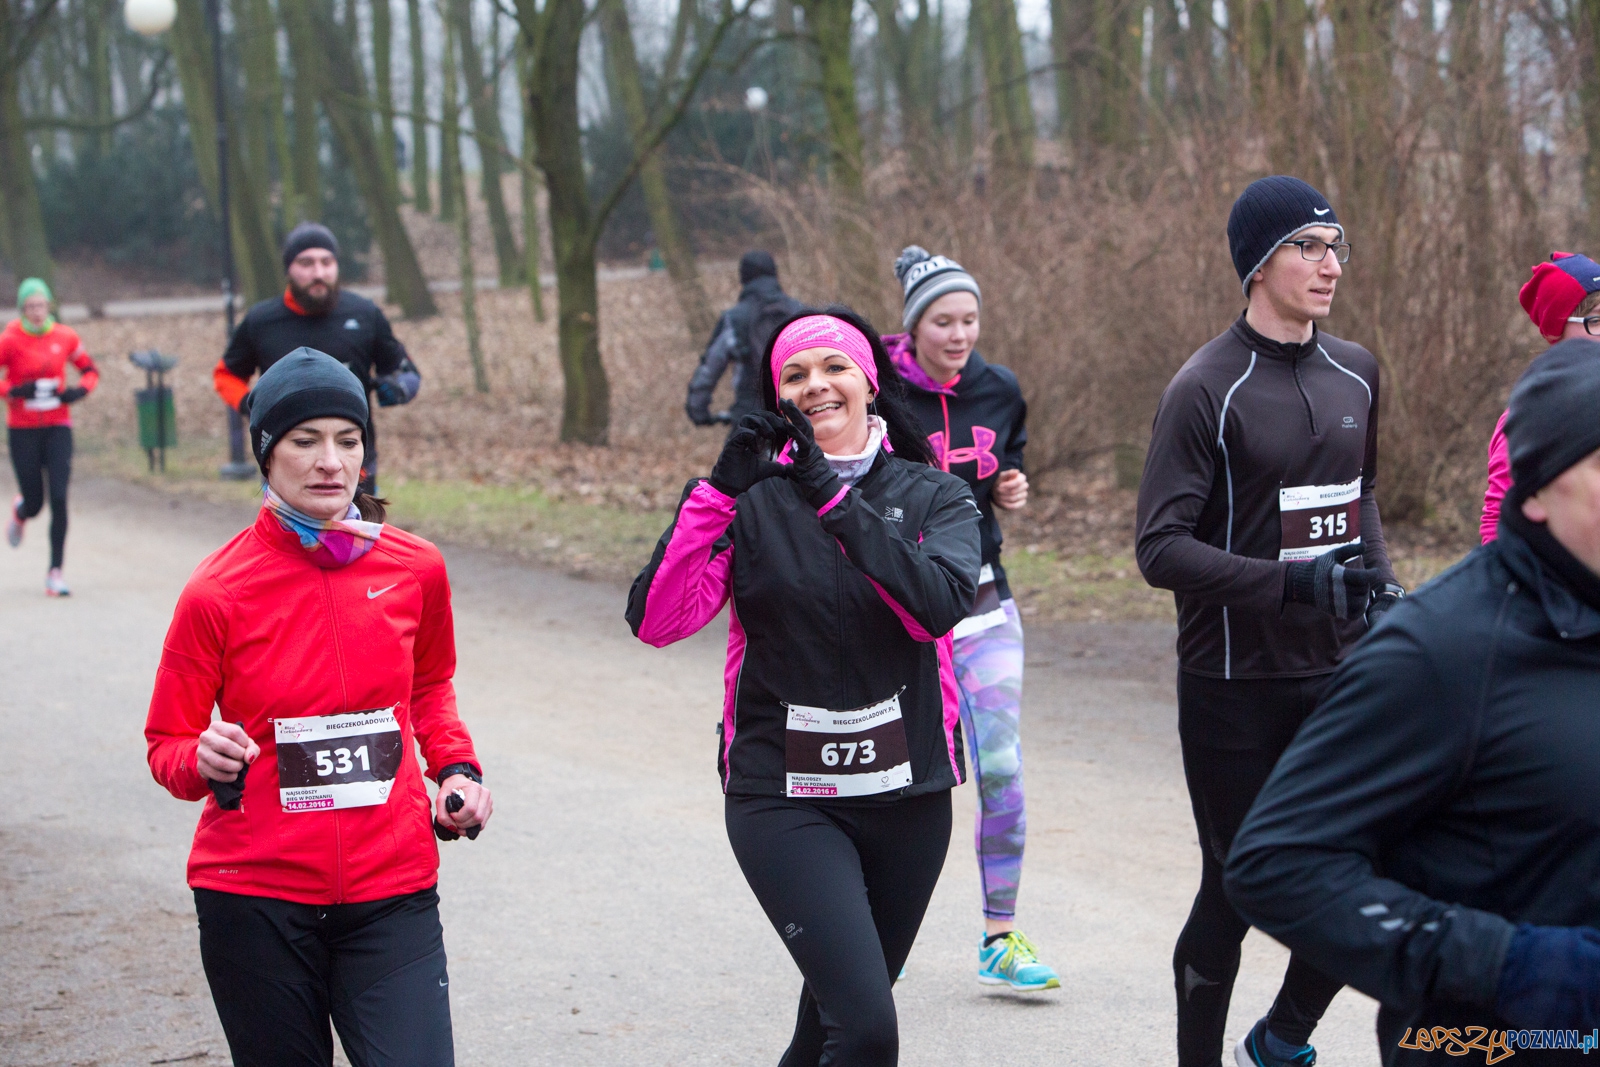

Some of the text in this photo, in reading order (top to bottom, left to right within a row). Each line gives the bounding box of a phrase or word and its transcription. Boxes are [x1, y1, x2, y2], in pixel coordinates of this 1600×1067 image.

[1309, 512, 1347, 539] 315
[832, 705, 896, 726] BIEGCZEKOLADOWY.PL
[316, 745, 371, 777] 531
[821, 739, 877, 767] 673
[287, 800, 326, 810] 14.02.2016
